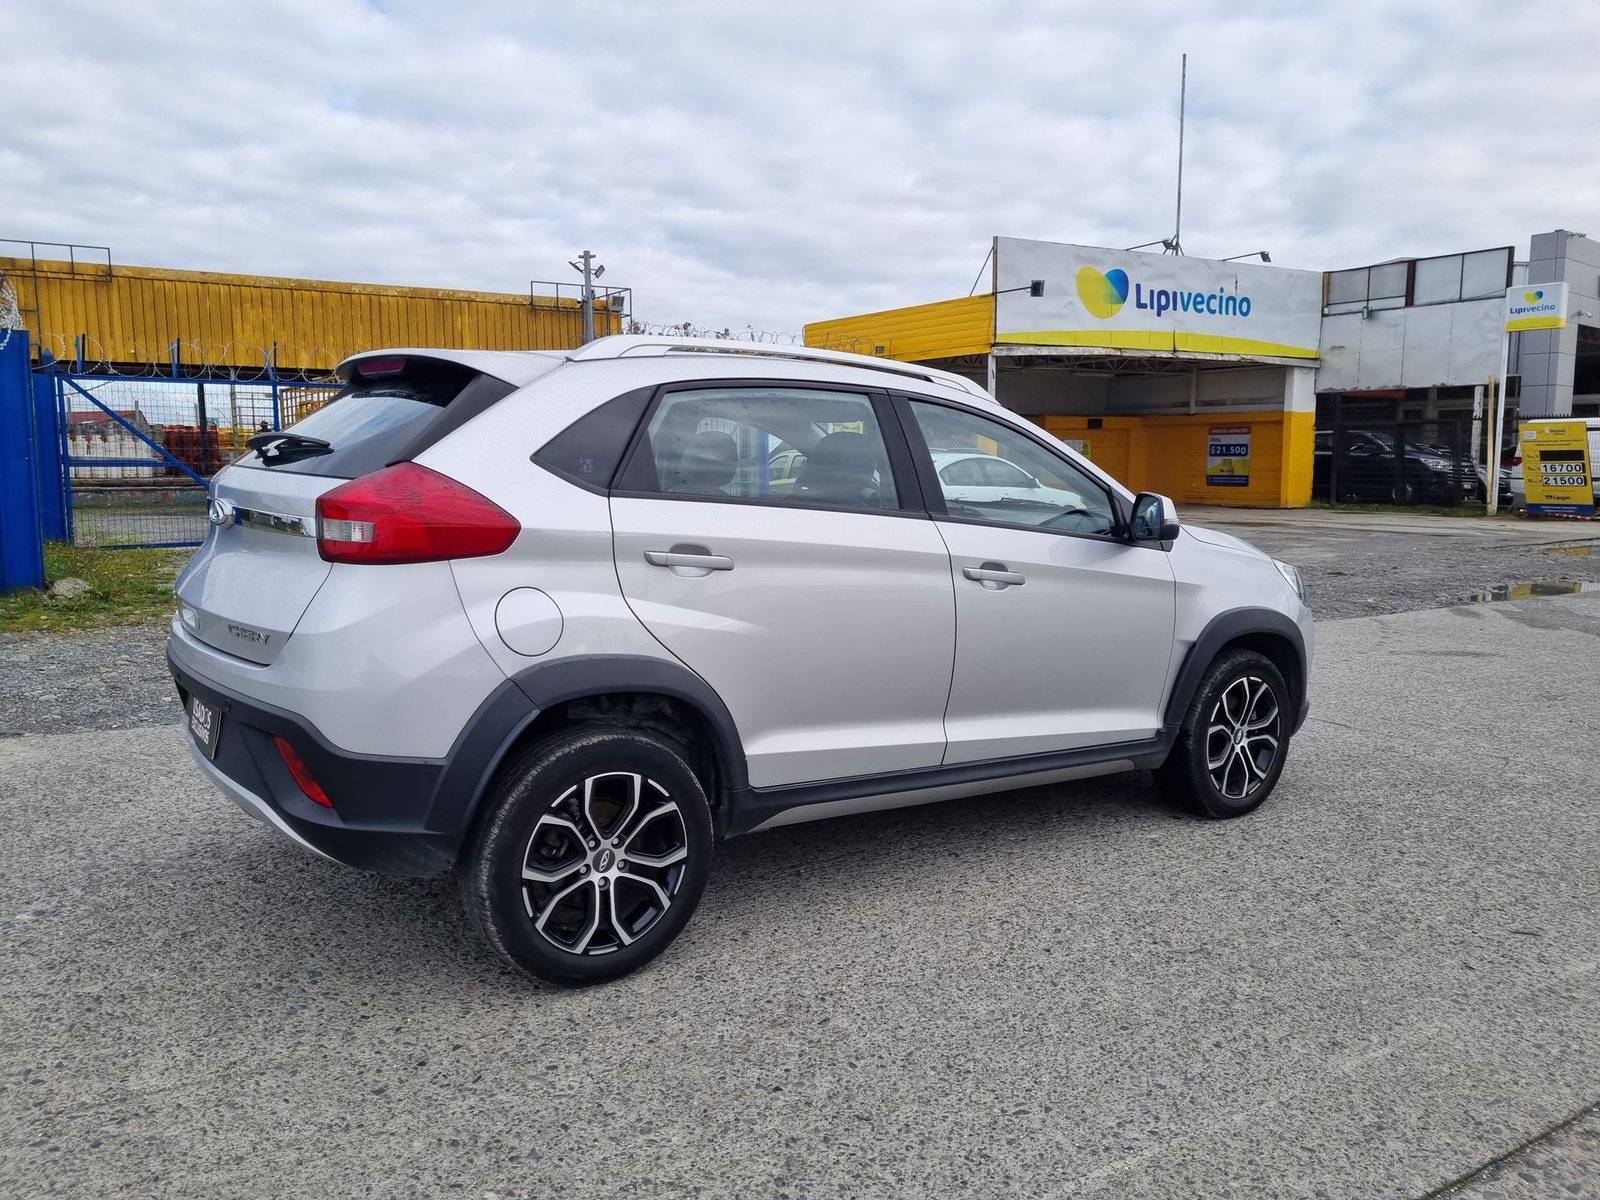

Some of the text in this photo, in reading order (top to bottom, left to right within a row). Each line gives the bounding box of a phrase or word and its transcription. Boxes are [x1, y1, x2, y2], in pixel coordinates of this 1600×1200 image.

[1135, 283, 1251, 317] Lipivecino
[1510, 303, 1556, 315] Lipivecino
[1210, 446, 1247, 455] $21.500
[1542, 464, 1582, 473] 16700
[1543, 476, 1584, 485] 21500
[227, 623, 271, 645] CHERY
